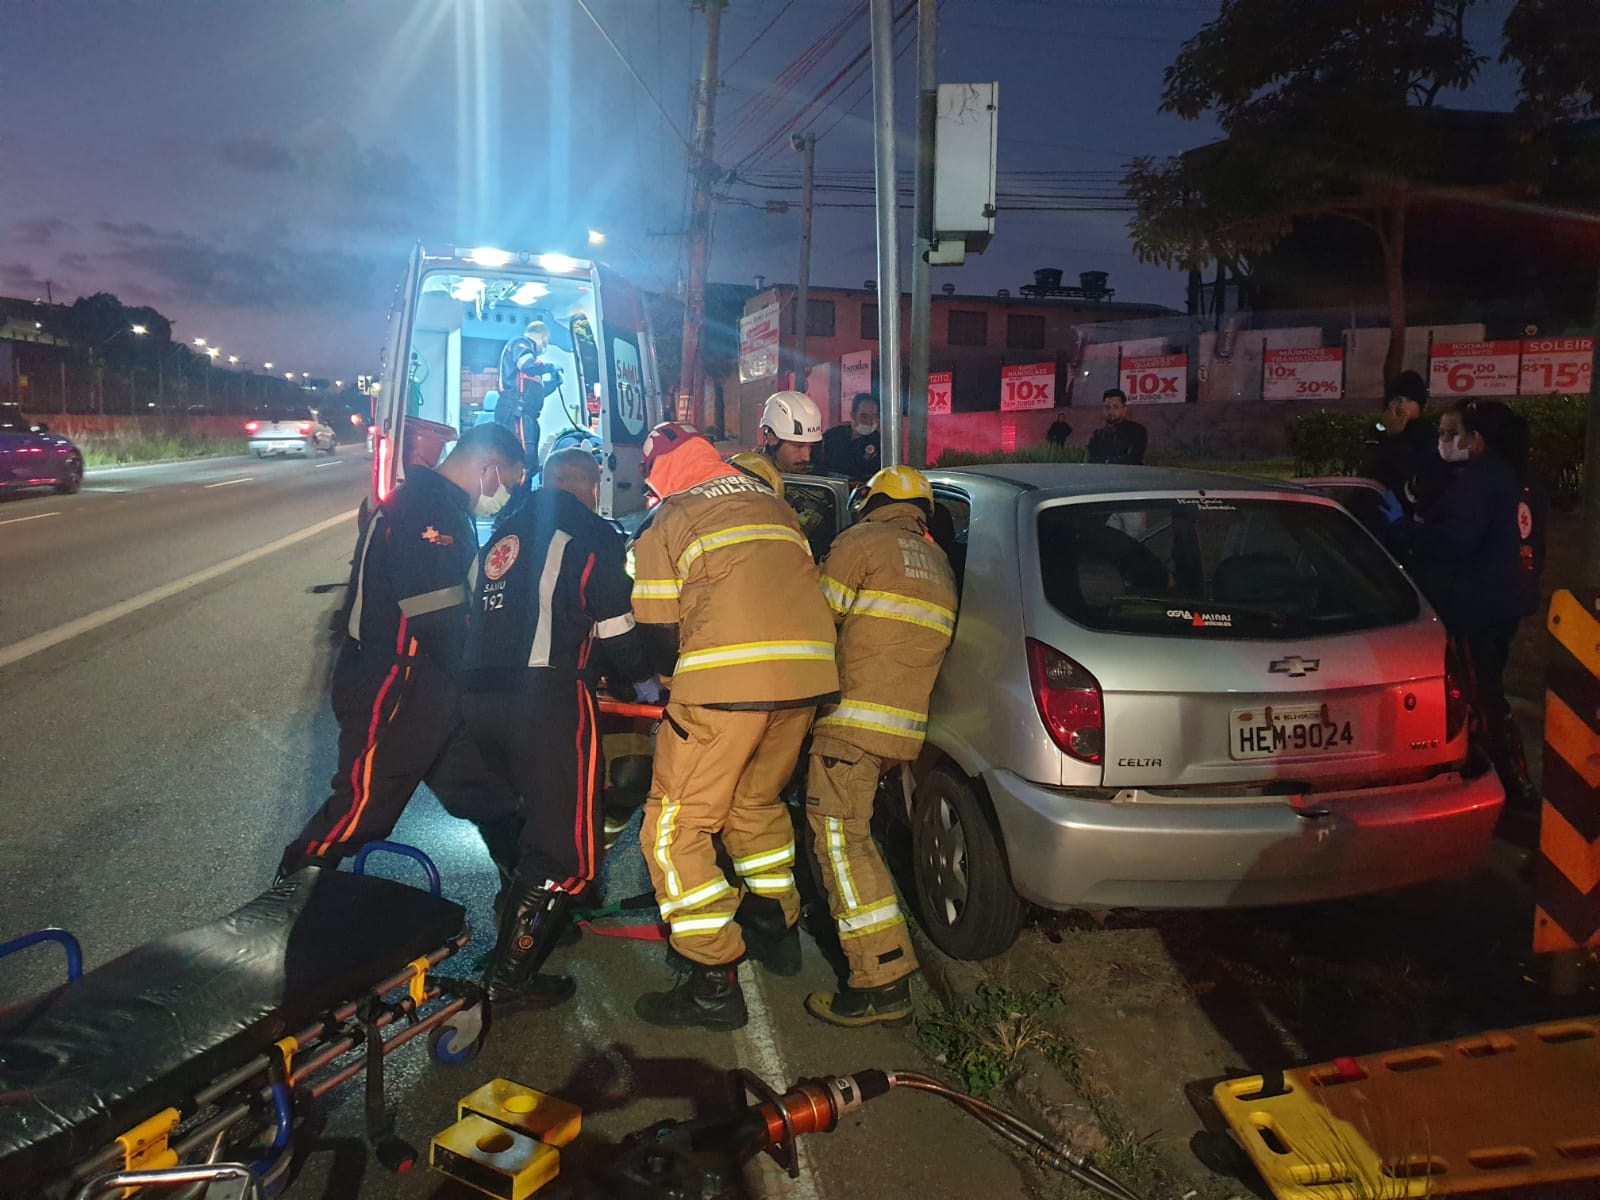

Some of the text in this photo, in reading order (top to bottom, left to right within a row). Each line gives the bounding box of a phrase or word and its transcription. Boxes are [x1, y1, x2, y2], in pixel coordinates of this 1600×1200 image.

[1529, 340, 1593, 352] SOLEIR
[1267, 366, 1297, 377] 10x
[1126, 373, 1179, 395] 10x
[1295, 380, 1338, 393] 30%
[1006, 381, 1049, 401] 10x
[617, 382, 643, 421] 192
[483, 580, 506, 593] SAMU
[482, 593, 504, 611] 192
[1118, 758, 1162, 767] CELTA
